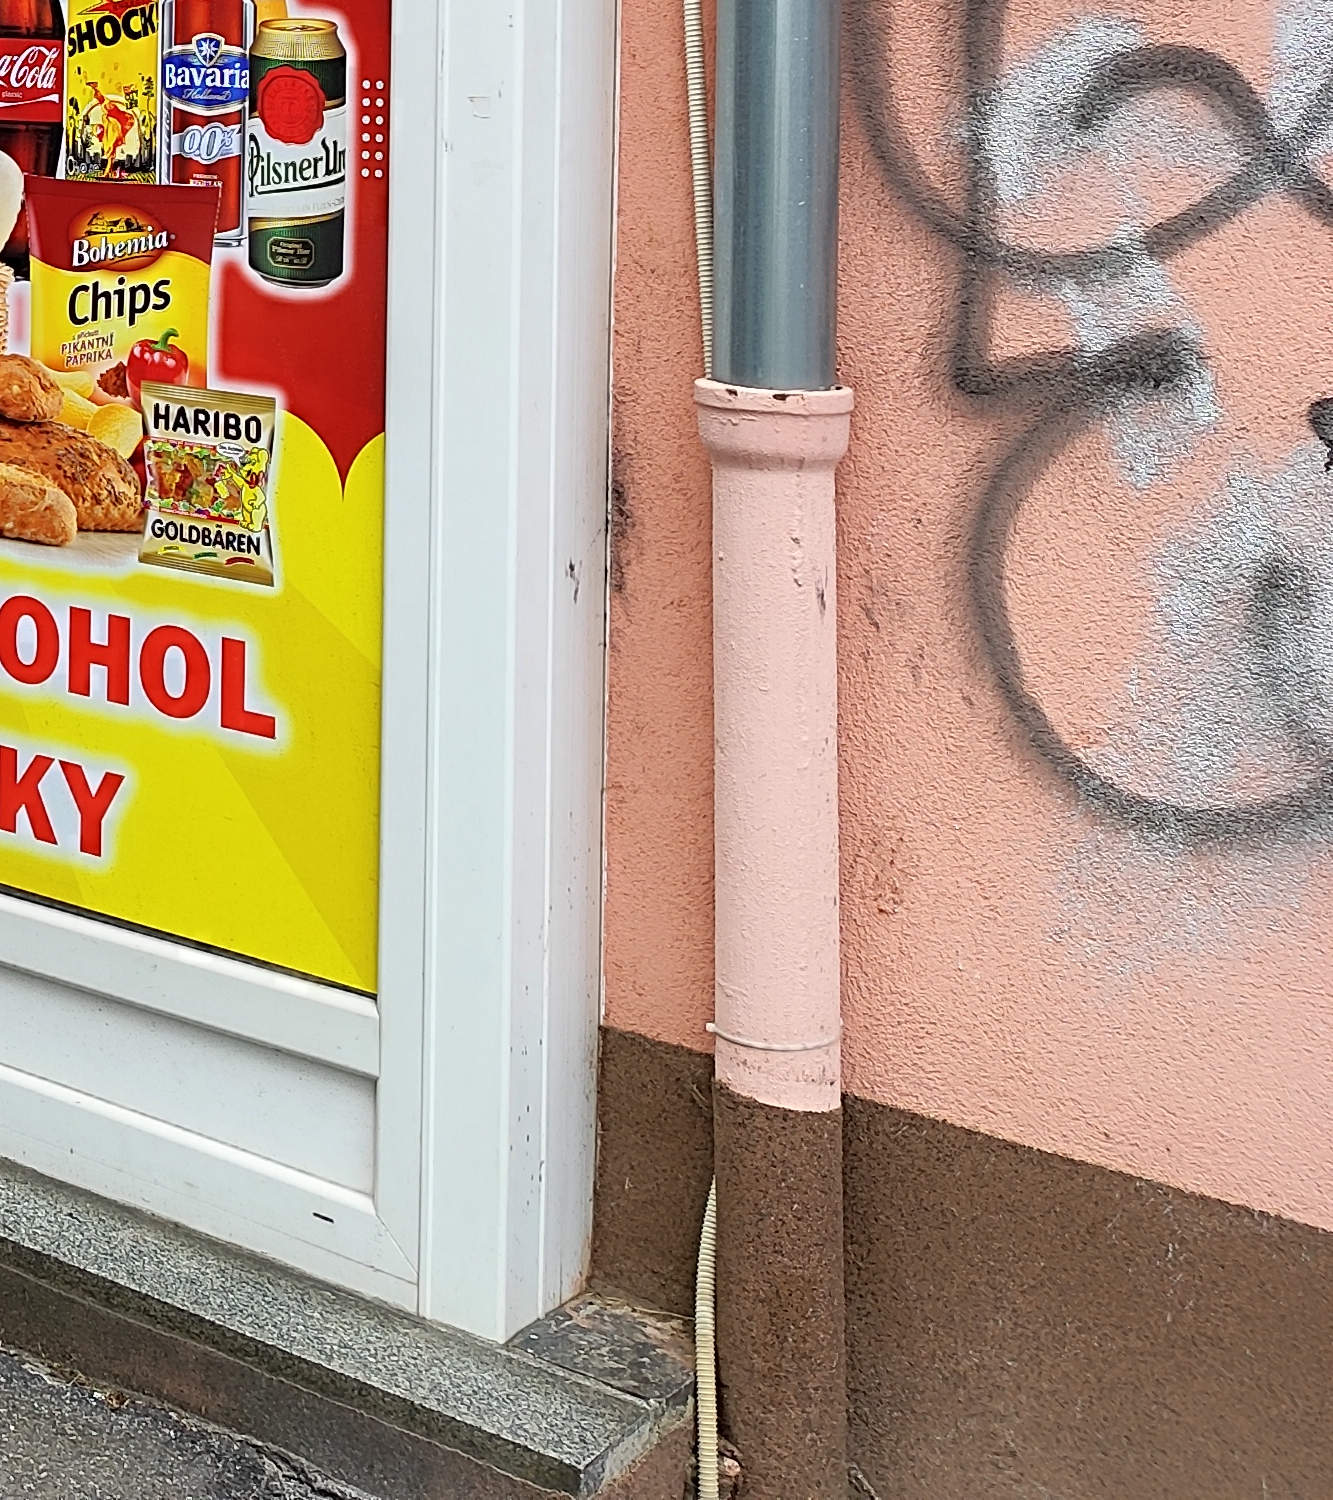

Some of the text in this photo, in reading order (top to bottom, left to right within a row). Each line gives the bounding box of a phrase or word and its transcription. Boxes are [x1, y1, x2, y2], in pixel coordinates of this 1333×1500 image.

[165, 63, 249, 89] Bavaria
[182, 88, 232, 100] Holland
[183, 126, 233, 160] 0.0%
[248, 133, 323, 197] Pilsner
[72, 225, 168, 267] Bohemia
[68, 276, 171, 327] Chips
[61, 332, 114, 355] PIKANTNÍ
[65, 349, 113, 367] PAPRIKA
[153, 402, 262, 443] HARIBO
[151, 518, 261, 556] GOLDBÄREN
